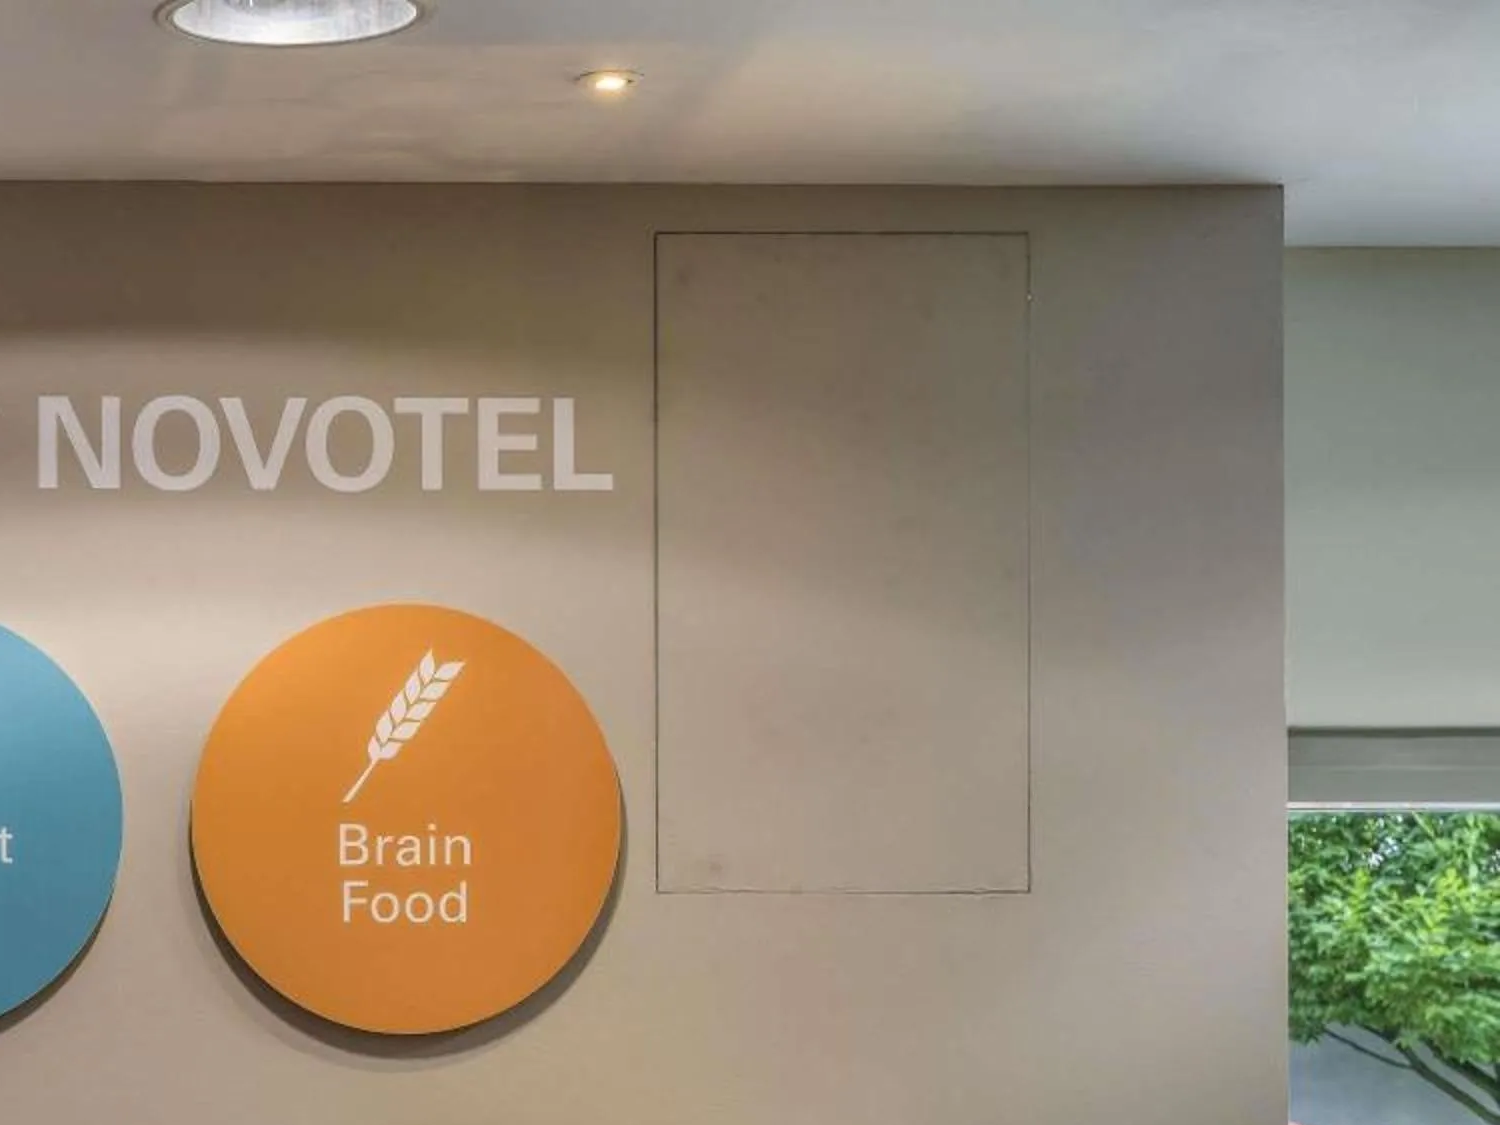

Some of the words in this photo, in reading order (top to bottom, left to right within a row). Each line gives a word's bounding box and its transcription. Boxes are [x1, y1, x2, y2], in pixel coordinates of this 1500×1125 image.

[37, 394, 614, 492] NOVOTEL
[337, 823, 473, 867] Brain
[341, 880, 469, 924] Food
